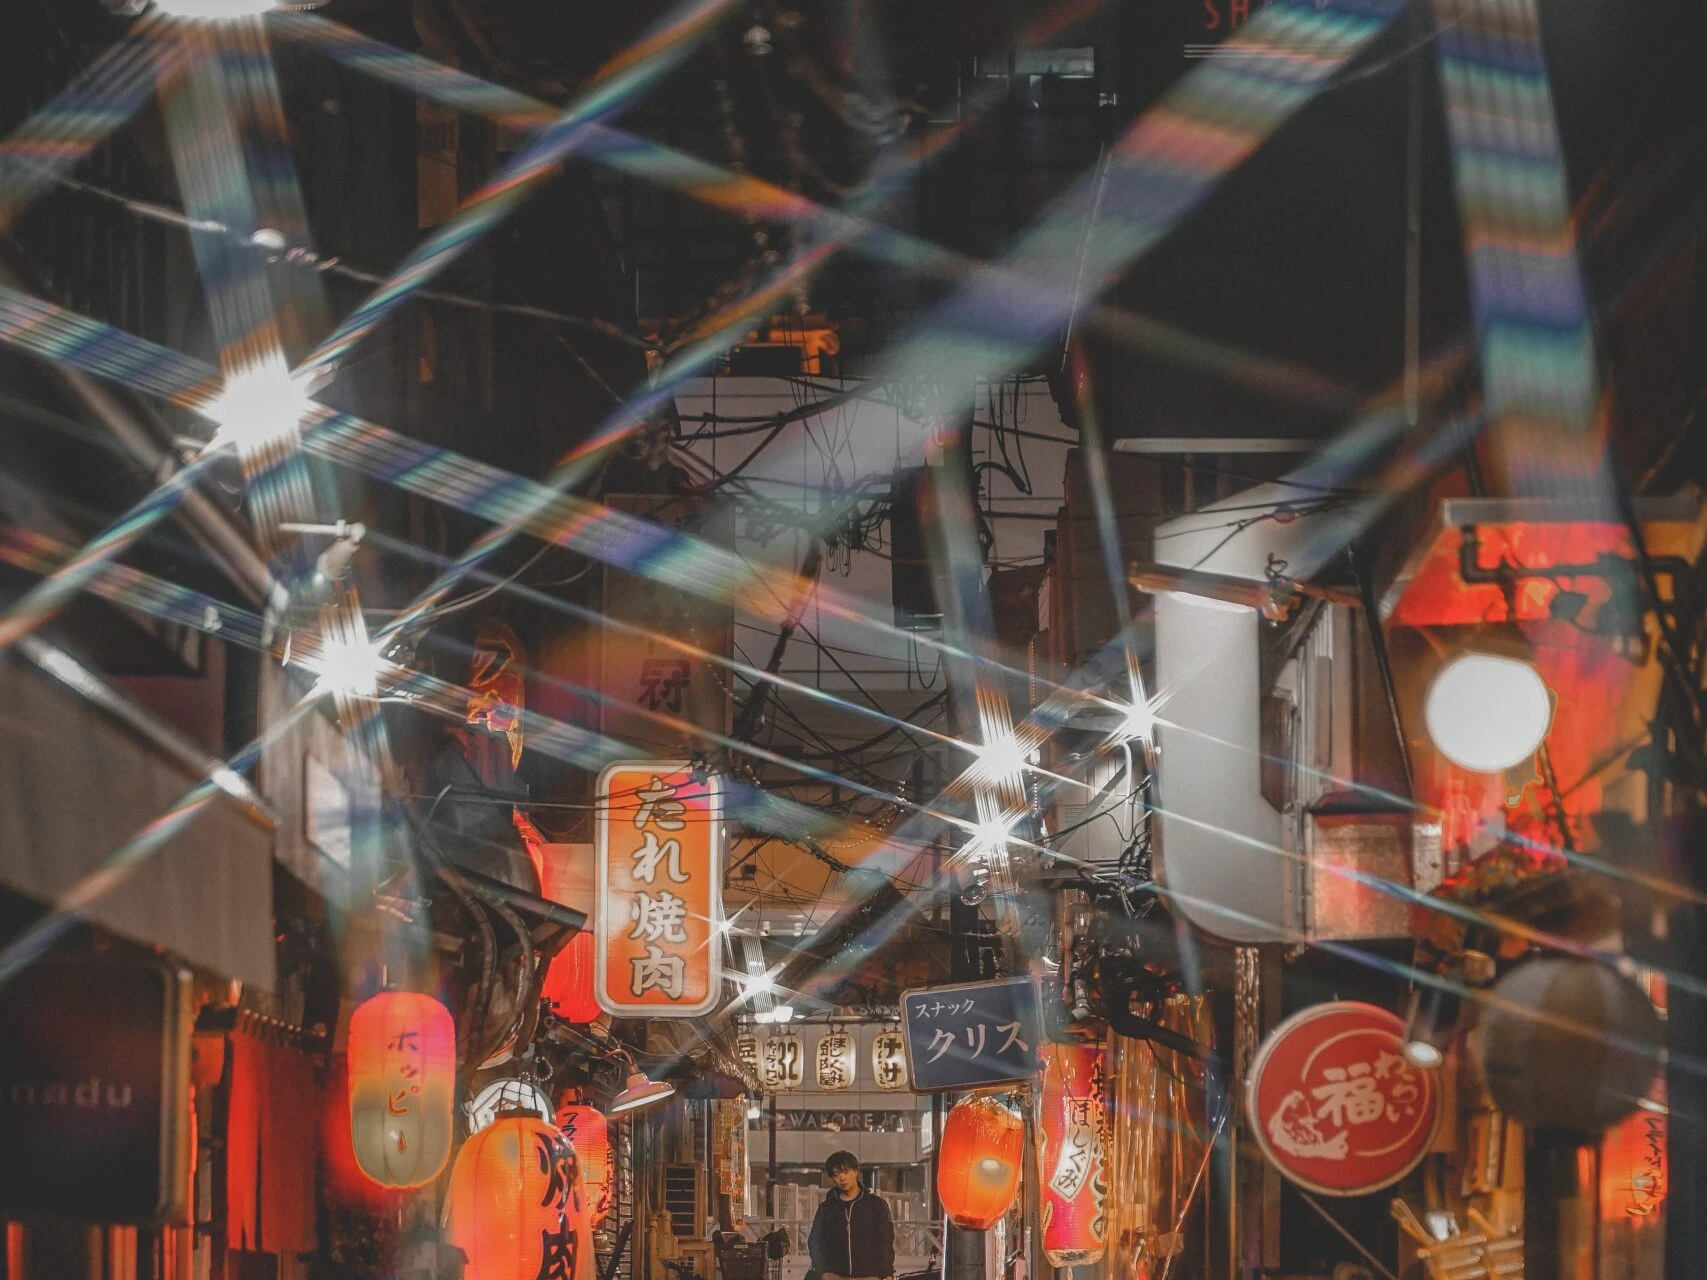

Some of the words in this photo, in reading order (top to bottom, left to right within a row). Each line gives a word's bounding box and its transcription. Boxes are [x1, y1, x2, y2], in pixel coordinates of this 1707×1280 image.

[629, 775, 690, 999] たれ焼肉
[915, 998, 975, 1018] スナック
[777, 1041, 798, 1081] 32
[926, 1020, 1029, 1064] クリス
[388, 1024, 420, 1153] ホッピー
[1058, 1101, 1089, 1188] ほしぐみ
